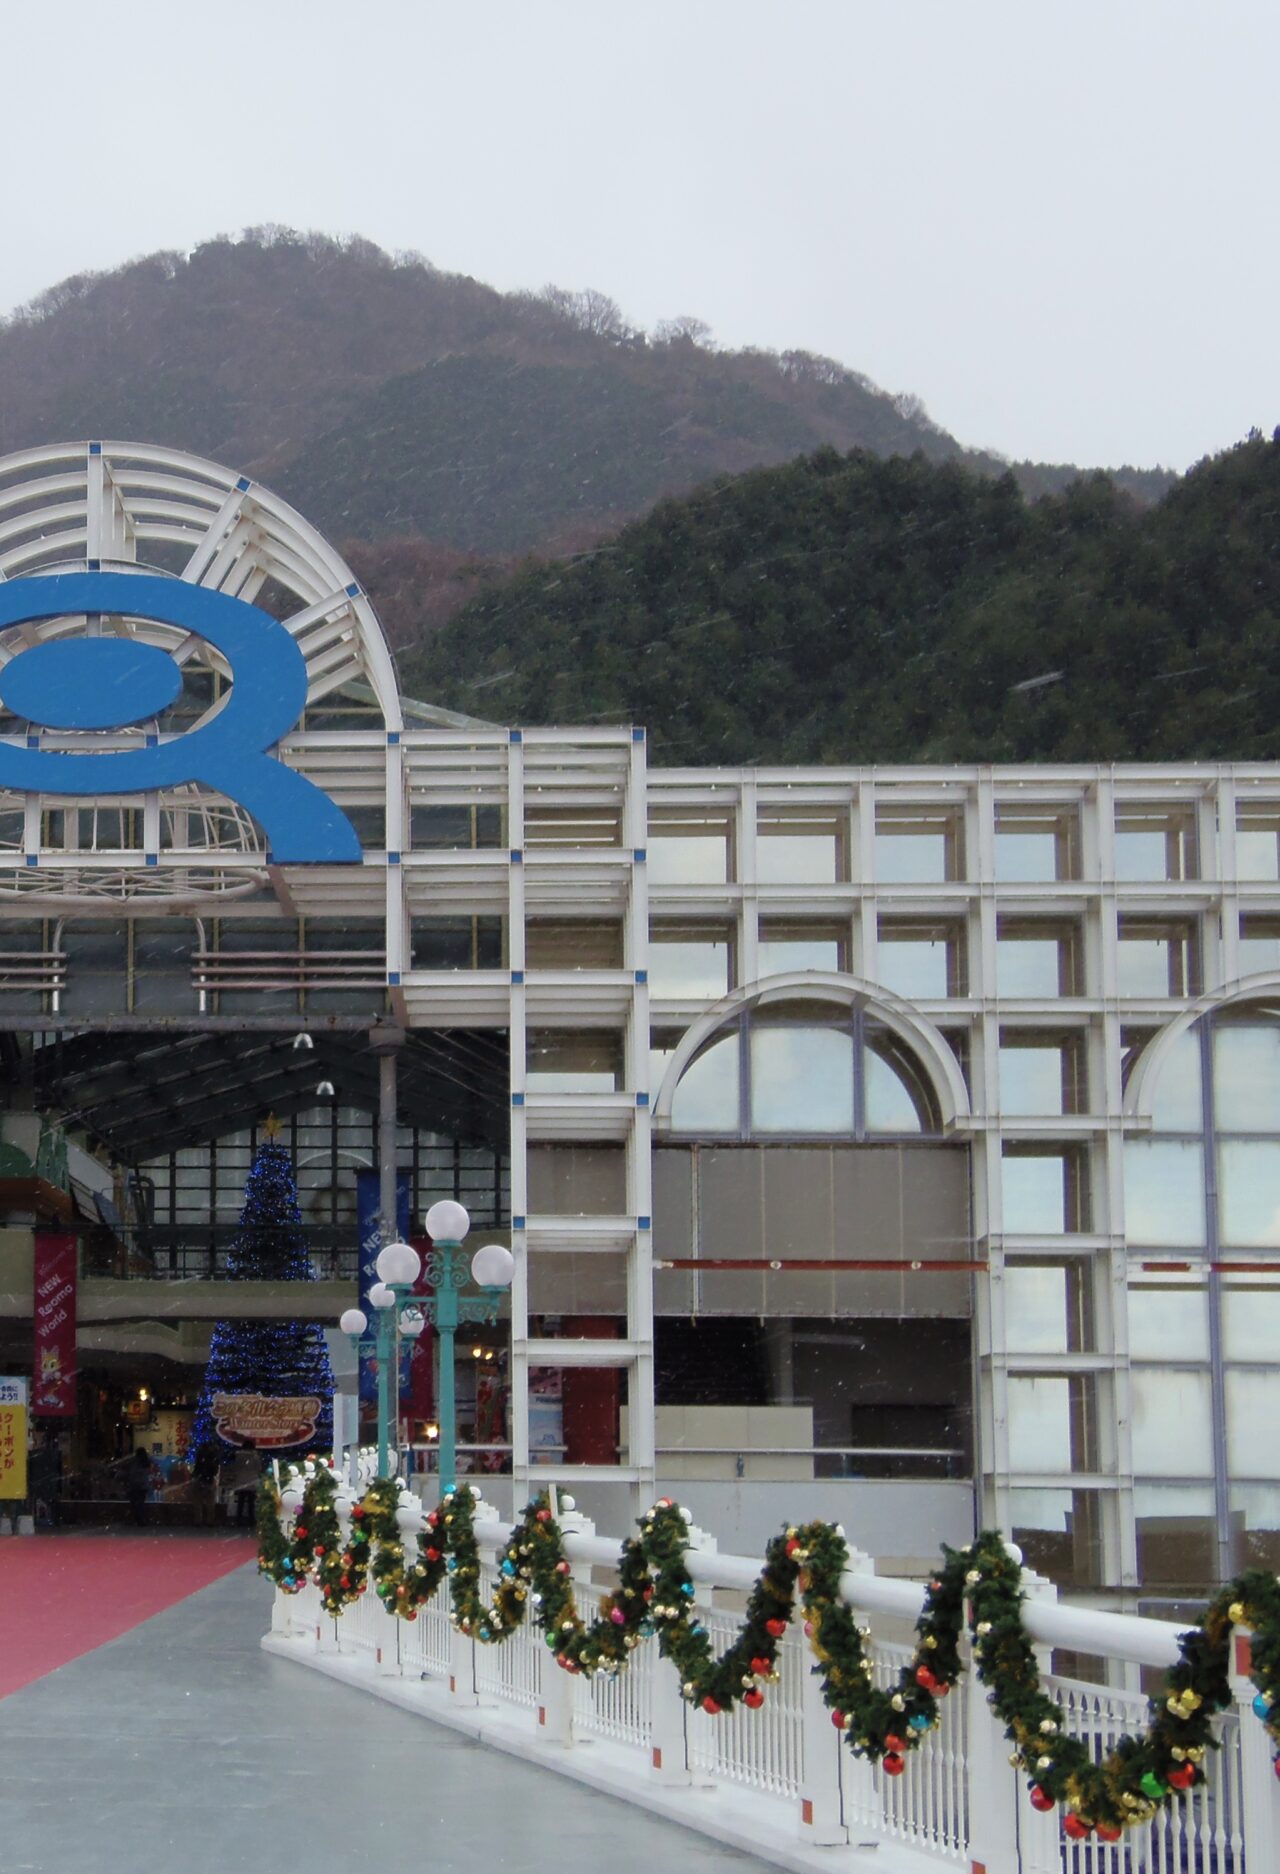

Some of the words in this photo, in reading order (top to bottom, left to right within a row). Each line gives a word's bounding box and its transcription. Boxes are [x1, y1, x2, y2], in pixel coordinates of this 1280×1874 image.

[38, 1273, 62, 1298] NEW
[38, 1284, 73, 1317] Reoma
[38, 1309, 68, 1337] World
[4, 1412, 15, 1469] クーポンが
